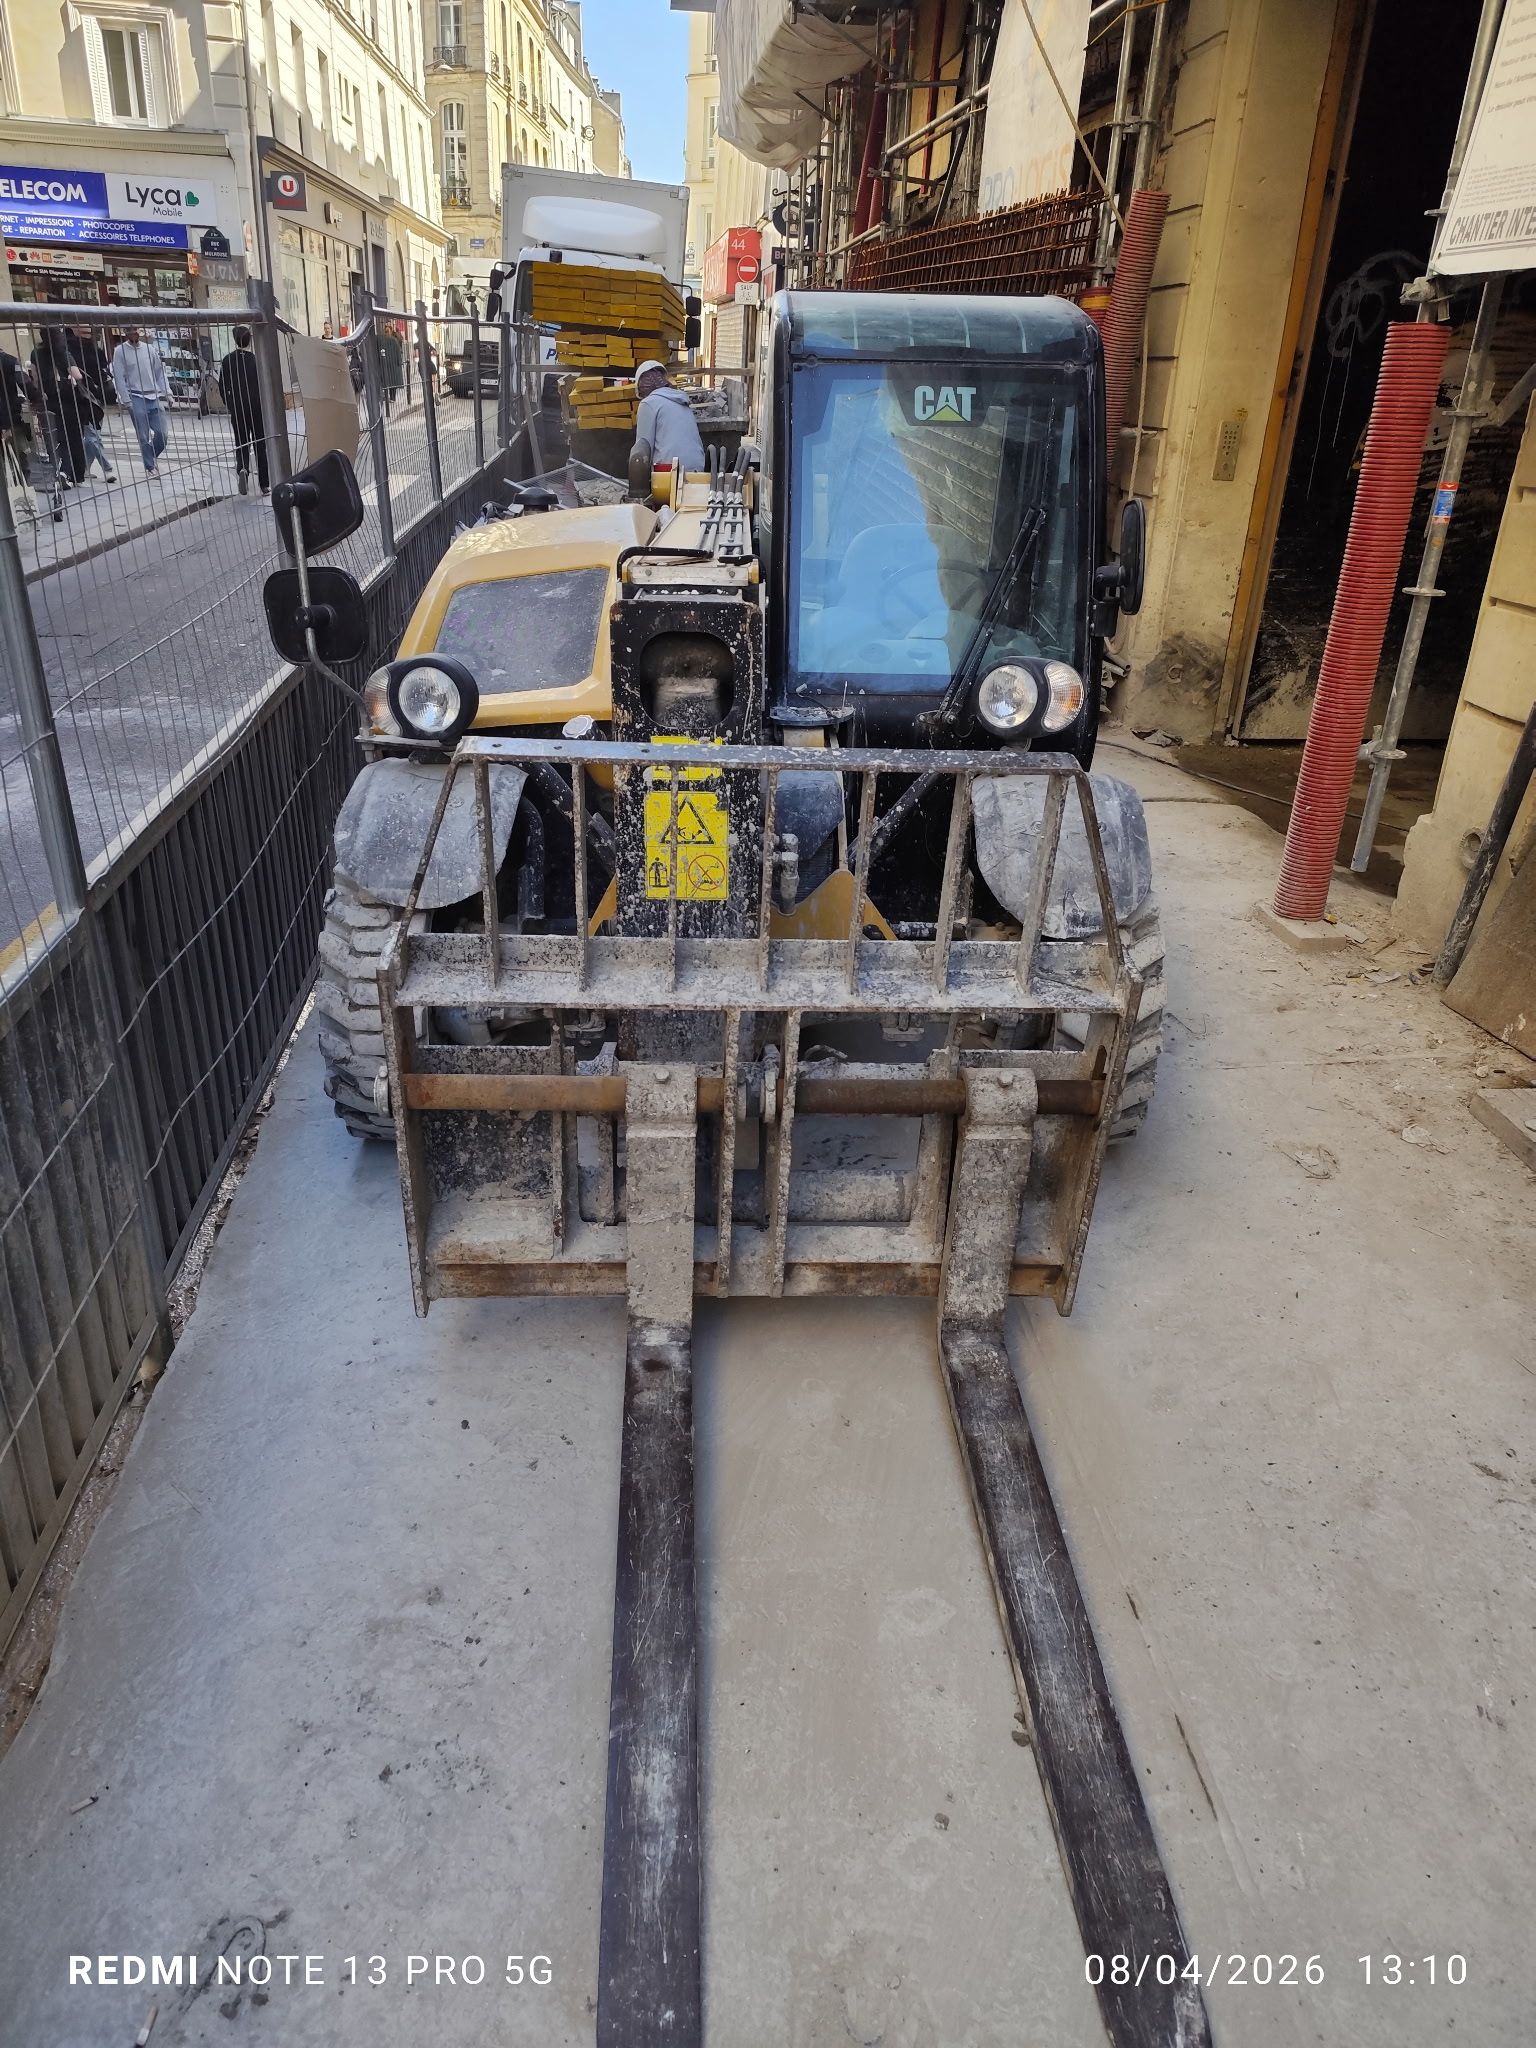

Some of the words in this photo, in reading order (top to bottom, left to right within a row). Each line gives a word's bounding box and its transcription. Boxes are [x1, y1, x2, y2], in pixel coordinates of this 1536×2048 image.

[282, 179, 294, 193] U
[125, 181, 181, 208] Lyca
[153, 207, 183, 217] Mobile
[25, 216, 74, 227] IMPRESSIONS
[83, 220, 135, 231] PHOTOCOPIES
[1450, 209, 1509, 246] CHANTIER
[1505, 205, 1536, 239] INTE
[19, 226, 66, 236] REPARATION
[79, 230, 127, 241] ACCESSOIRES
[129, 234, 175, 244] TELEPHONES
[731, 239, 746, 250] 44
[914, 385, 977, 421] CAT
